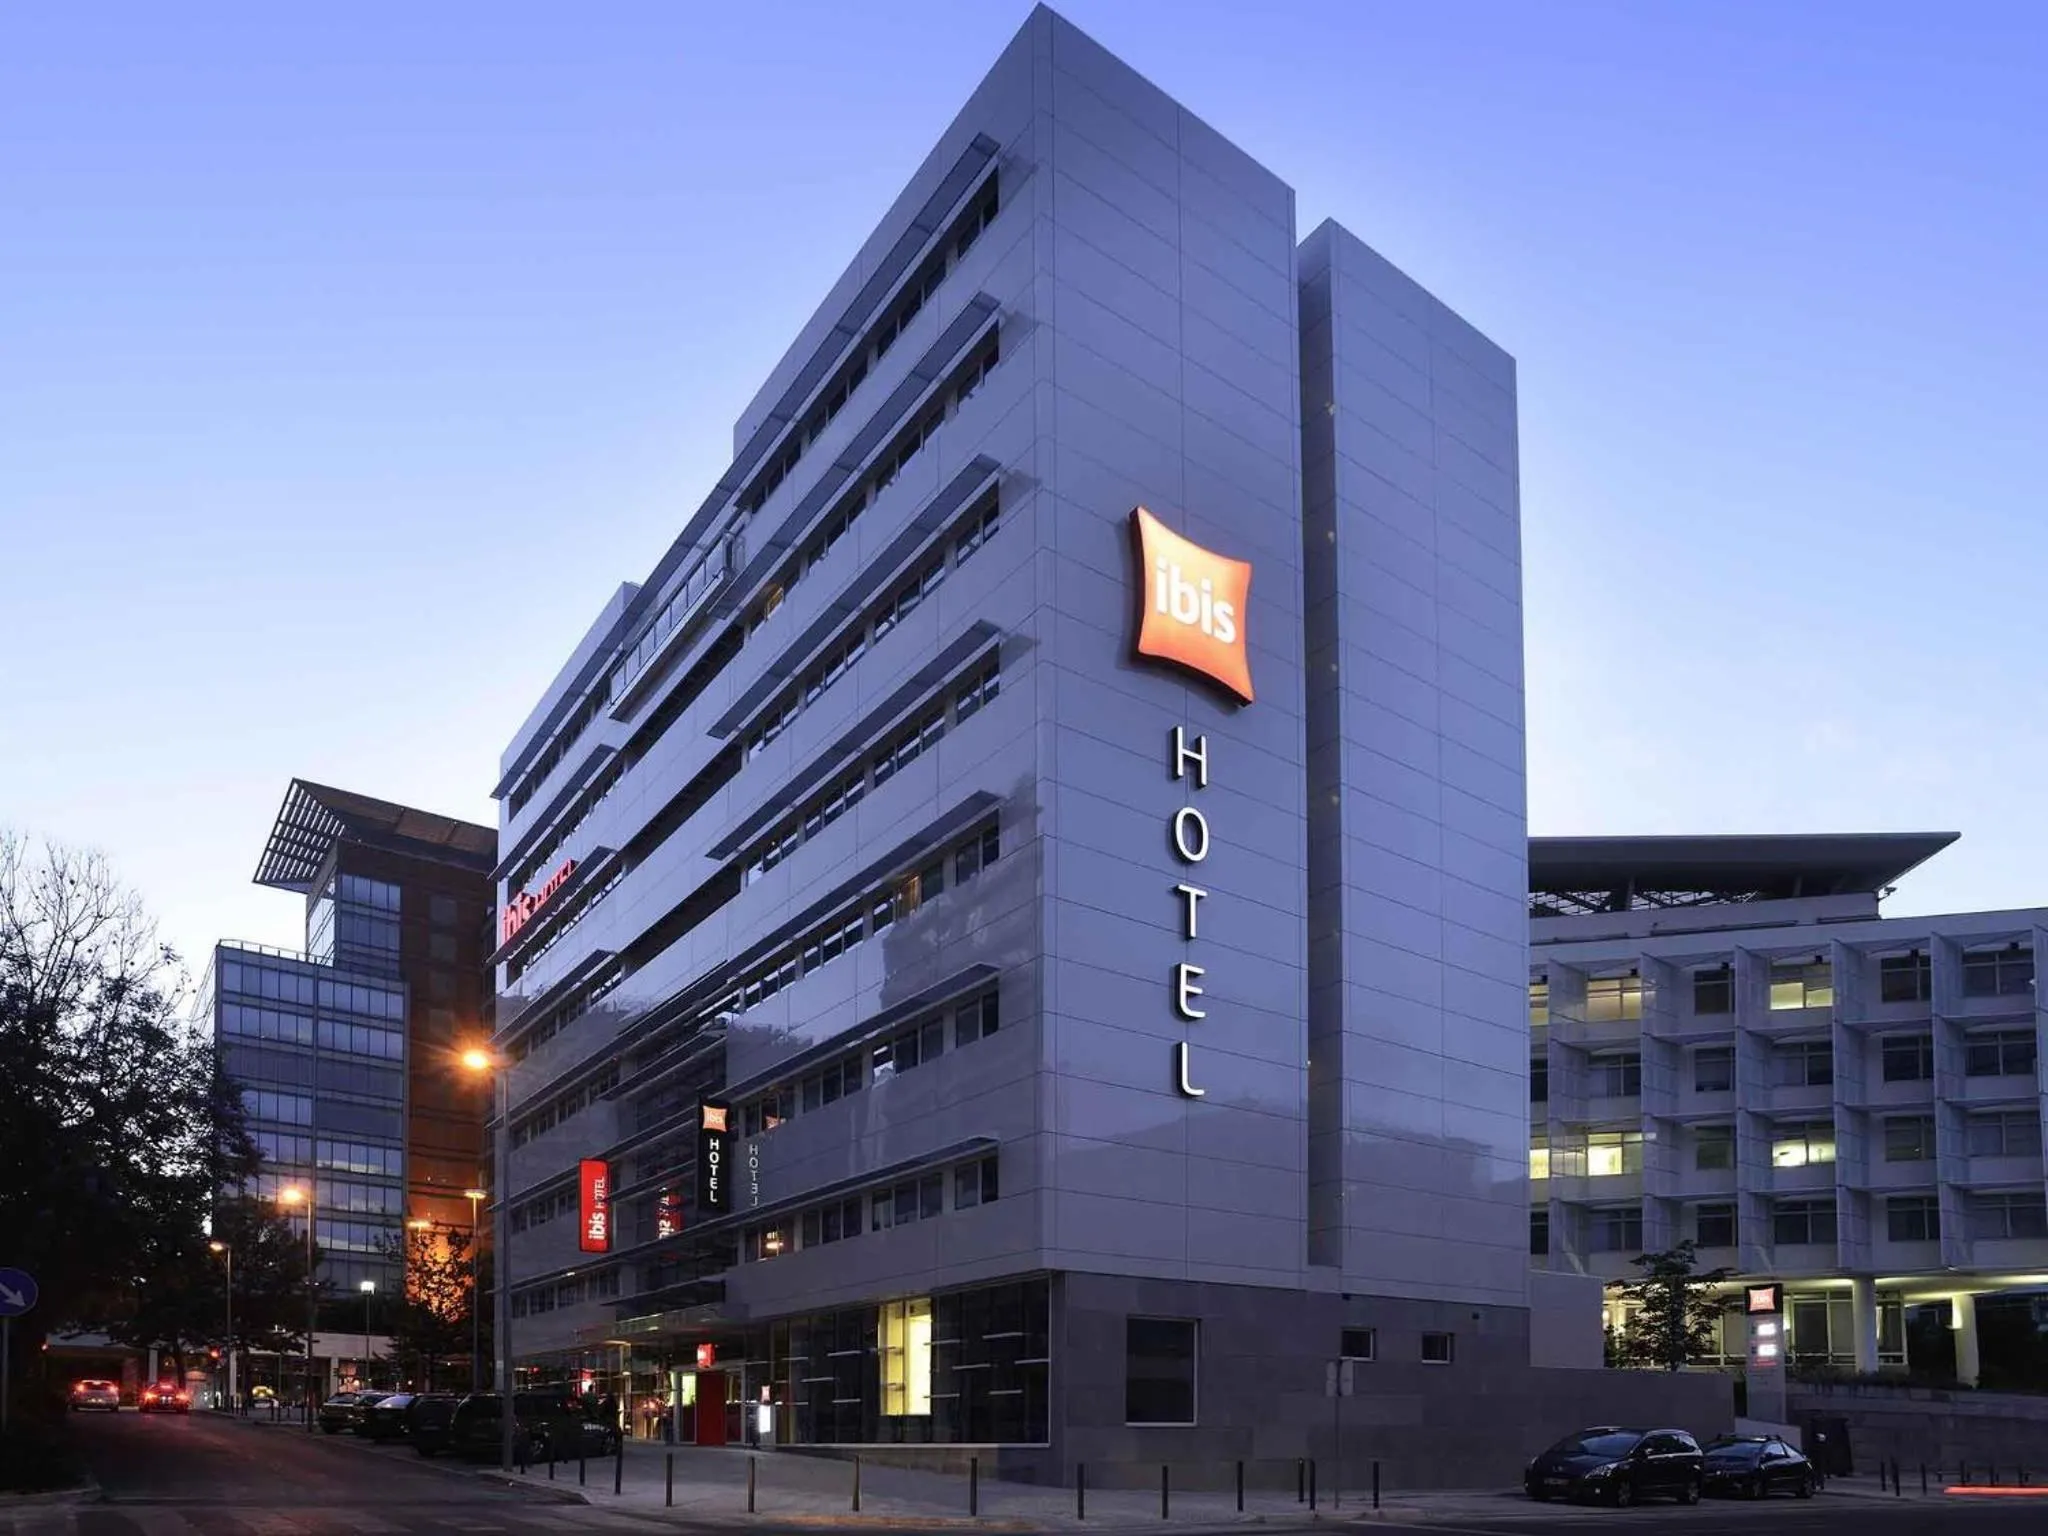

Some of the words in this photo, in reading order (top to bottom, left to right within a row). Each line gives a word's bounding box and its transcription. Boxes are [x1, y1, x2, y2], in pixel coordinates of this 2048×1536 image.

[1155, 555, 1237, 644] ibis
[1173, 725, 1209, 1097] HOTEL
[709, 1138, 719, 1203] HOTEL
[588, 1212, 606, 1240] ibis
